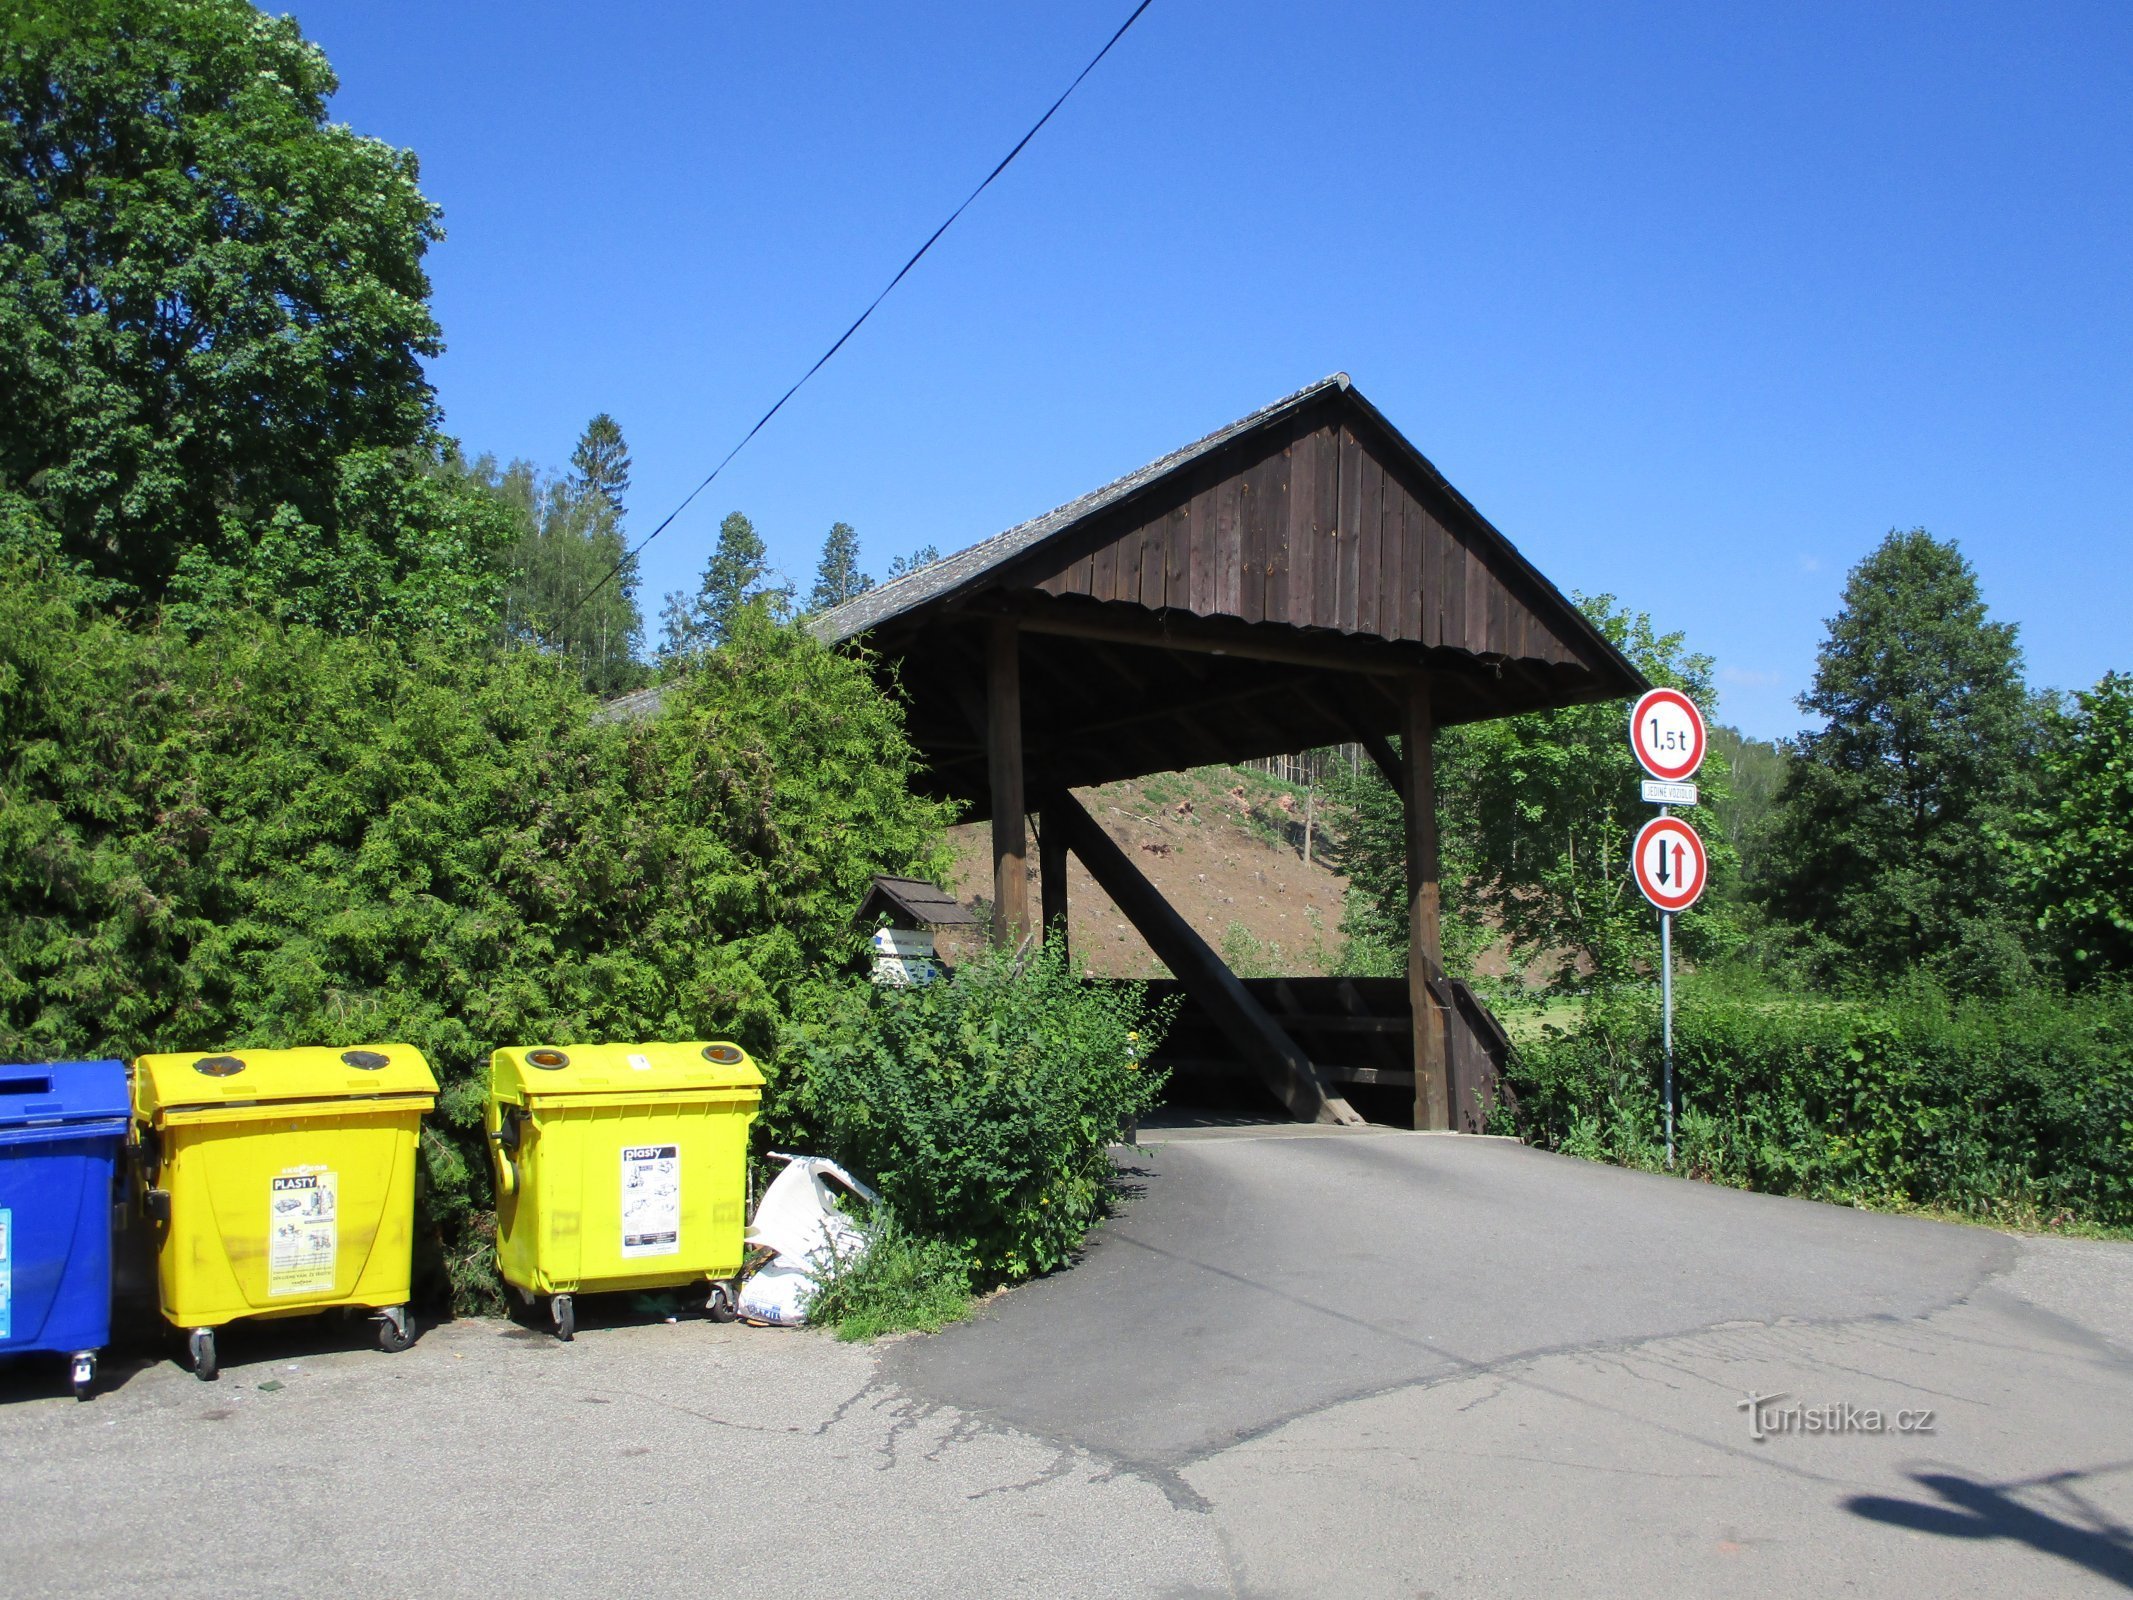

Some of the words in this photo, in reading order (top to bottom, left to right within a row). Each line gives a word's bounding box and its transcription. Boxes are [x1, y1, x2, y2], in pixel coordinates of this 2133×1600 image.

[1647, 785, 1667, 798] JEDINÉ
[1668, 787, 1693, 800] VOZIDLO
[626, 1148, 661, 1161] plasty
[275, 1177, 315, 1190] PLASTY
